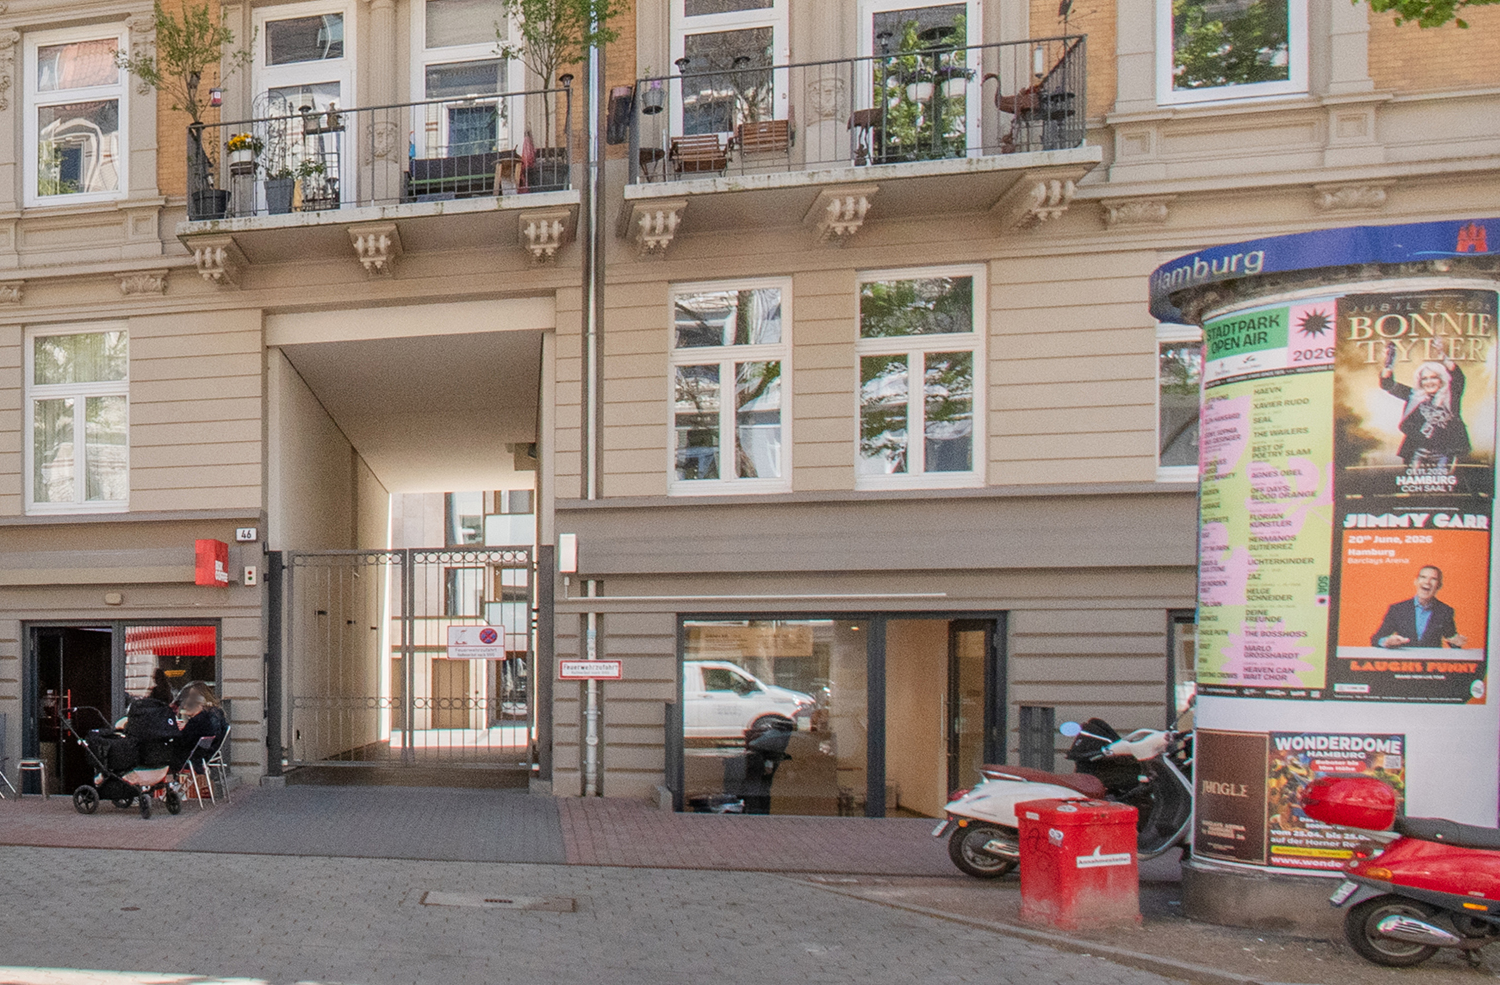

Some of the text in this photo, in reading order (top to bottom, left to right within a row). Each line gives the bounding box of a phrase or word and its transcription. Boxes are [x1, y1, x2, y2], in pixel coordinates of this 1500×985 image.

[1154, 250, 1265, 289] Hamburg
[1349, 300, 1444, 314] JUBILEE
[1206, 315, 1280, 342] STADTPARK
[1348, 312, 1492, 340] BONNIE
[1211, 331, 1268, 354] OPEN AIR
[1293, 348, 1335, 362] 2026
[1356, 337, 1486, 364] TYLER
[1253, 386, 1282, 395] HAEVN
[1253, 399, 1283, 409] XAVIER
[1252, 416, 1272, 424] SEAL
[1269, 427, 1309, 436] WAILERS
[1252, 448, 1311, 459] POETRY SLAM
[1251, 470, 1278, 478] AGNES
[1395, 475, 1458, 485] HAMBURG
[1423, 484, 1447, 492] SAAL
[1279, 490, 1317, 498] ORANGE
[1343, 513, 1489, 529] JIMMY CARR
[241, 530, 252, 539] 46
[1248, 535, 1297, 543] HERMANOS
[1373, 535, 1403, 545] June,
[1405, 535, 1433, 544] 2026
[1347, 549, 1395, 557] Hamburg
[1247, 557, 1314, 565] LICHTERKINDER
[1347, 557, 1384, 565] Barclays
[1426, 661, 1478, 673] FUNNY
[1274, 736, 1401, 754] WONDERDOME
[1306, 750, 1366, 759] HAMBURG
[1326, 831, 1342, 839] bis
[1270, 836, 1286, 844] auf
[1305, 838, 1341, 847] Horner
[1271, 857, 1346, 868] www.wonde
